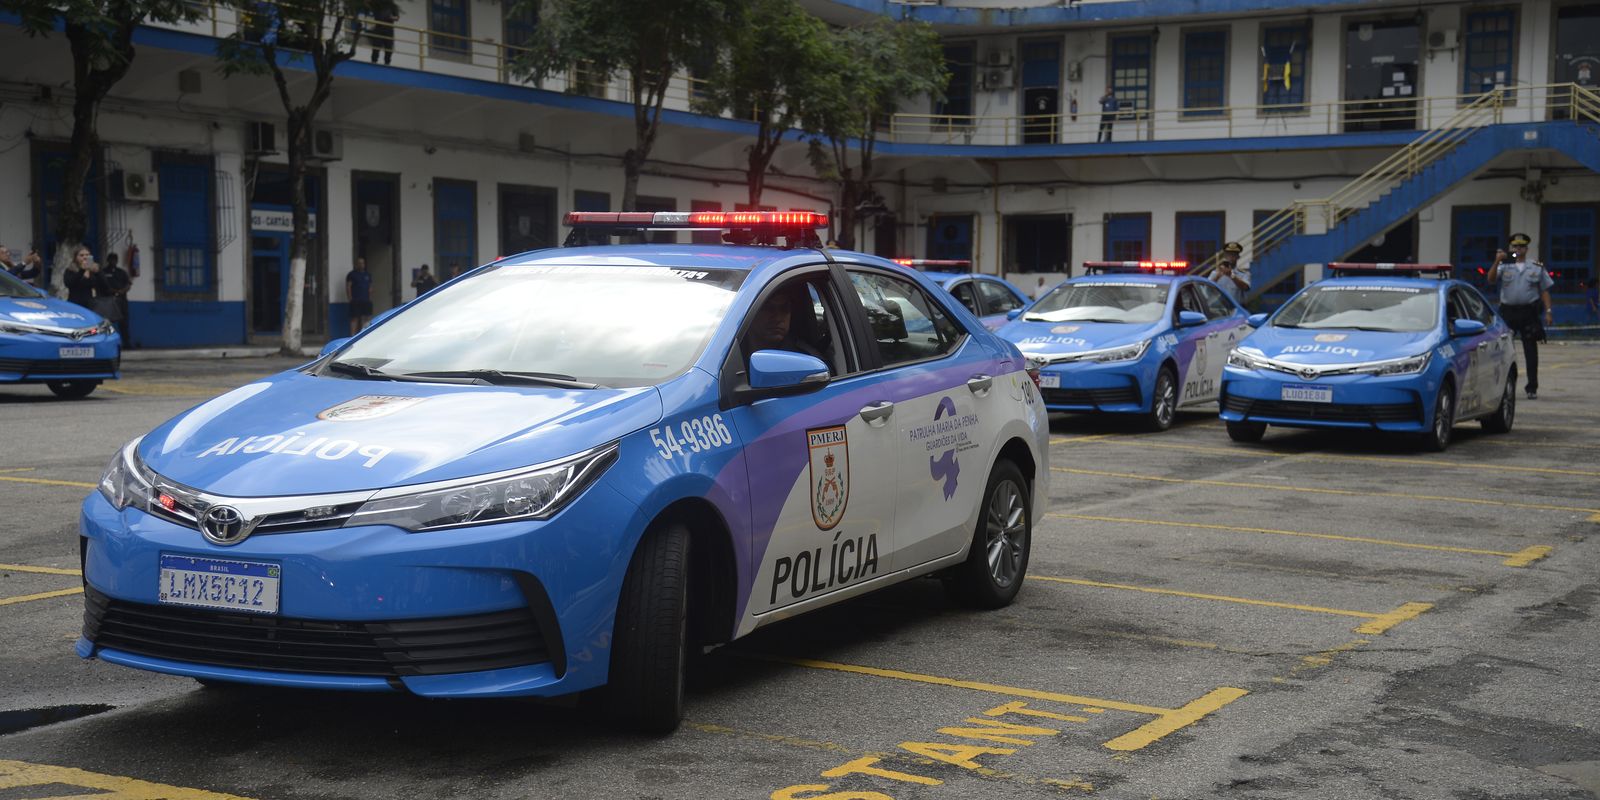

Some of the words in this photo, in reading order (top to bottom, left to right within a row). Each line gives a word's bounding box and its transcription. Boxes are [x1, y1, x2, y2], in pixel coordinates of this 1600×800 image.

[649, 413, 733, 460] 54-9386
[810, 430, 844, 446] PMERJ
[909, 425, 936, 441] PATRULHA
[936, 420, 953, 434] MARIA
[953, 418, 962, 430] DA
[962, 414, 979, 427] PENHA
[926, 435, 950, 450] GUARDIÕES
[950, 435, 957, 444] DA
[957, 432, 968, 442] VIDA
[209, 565, 229, 573] BRASIL
[769, 531, 879, 605] POLÍCIA
[169, 571, 265, 607] LMX5C12
